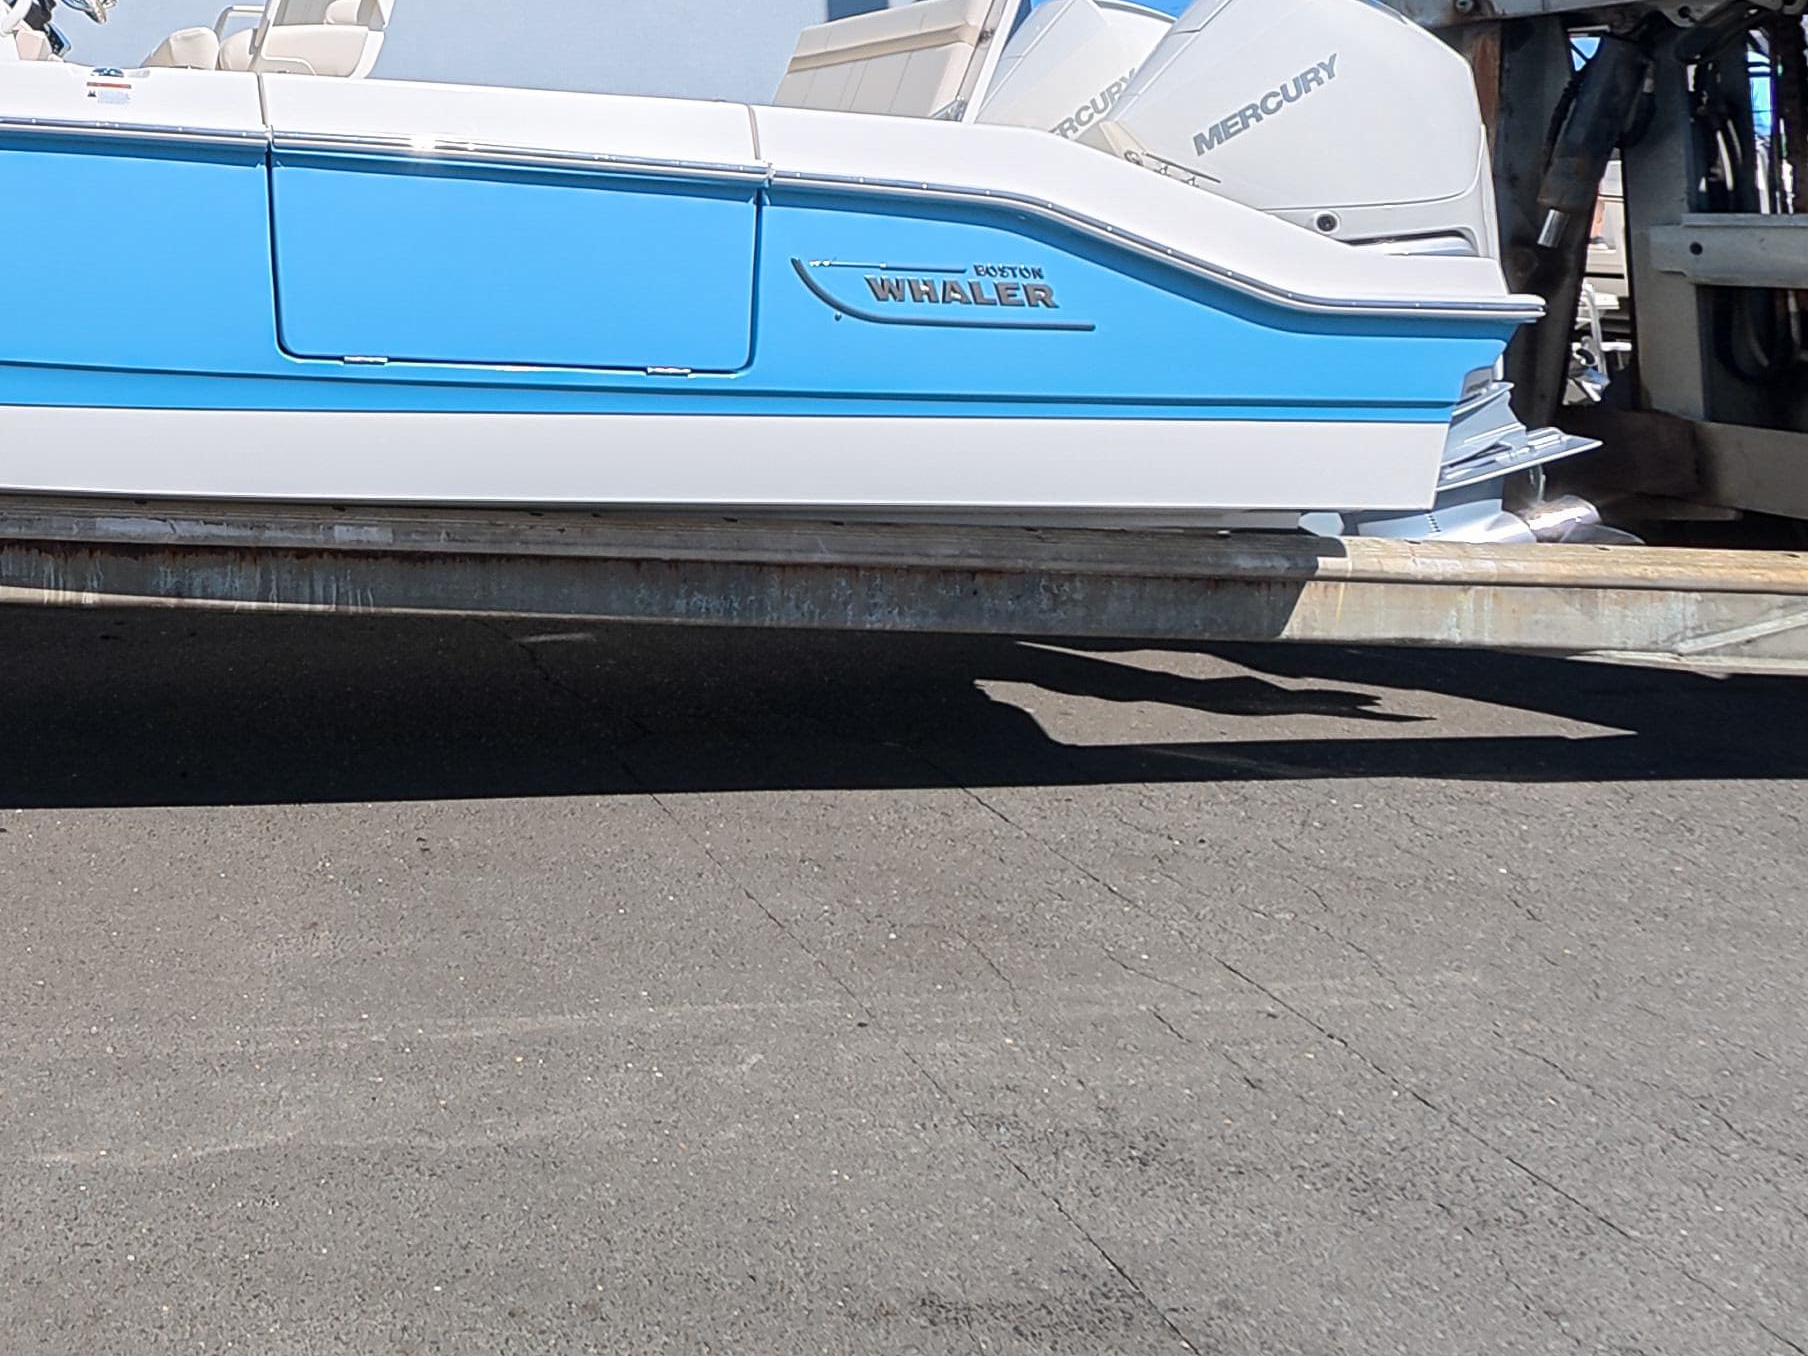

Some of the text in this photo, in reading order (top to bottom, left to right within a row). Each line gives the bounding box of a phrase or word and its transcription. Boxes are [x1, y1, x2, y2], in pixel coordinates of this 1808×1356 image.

[1192, 52, 1338, 156] MERCURY
[972, 264, 1044, 279] BOSTON
[864, 275, 1060, 309] WHALER
